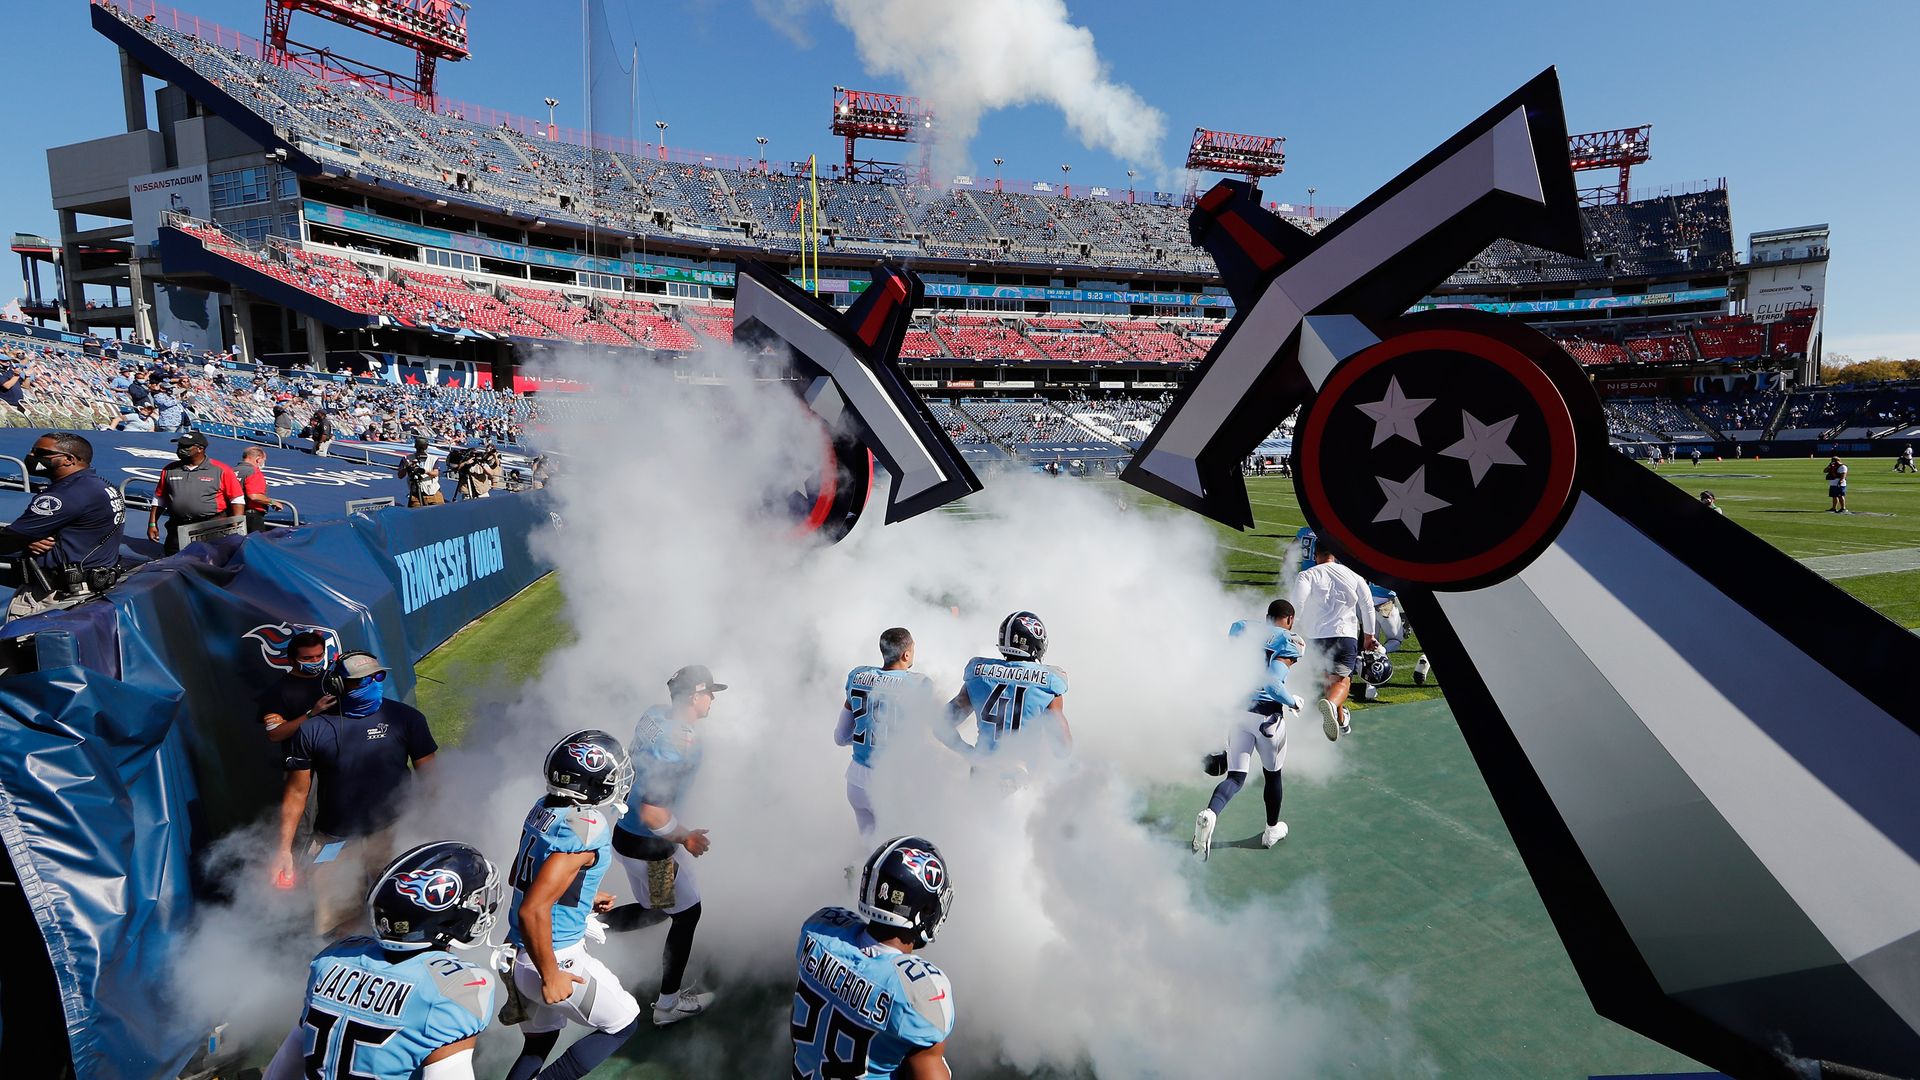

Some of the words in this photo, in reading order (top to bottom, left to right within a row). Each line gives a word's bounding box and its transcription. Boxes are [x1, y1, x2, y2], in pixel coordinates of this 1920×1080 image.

[1087, 292, 1104, 300] 9:23
[1607, 381, 1658, 390] NISSAN
[394, 536, 469, 615] TENNESSEE
[468, 526, 504, 581] TOUGH
[974, 663, 1049, 685] BLASINGAME
[981, 681, 1028, 740] 41
[313, 963, 414, 1018] JACKSON
[800, 934, 892, 1024] McNICHOLS
[303, 1003, 405, 1080] 35
[791, 974, 878, 1080] 28
